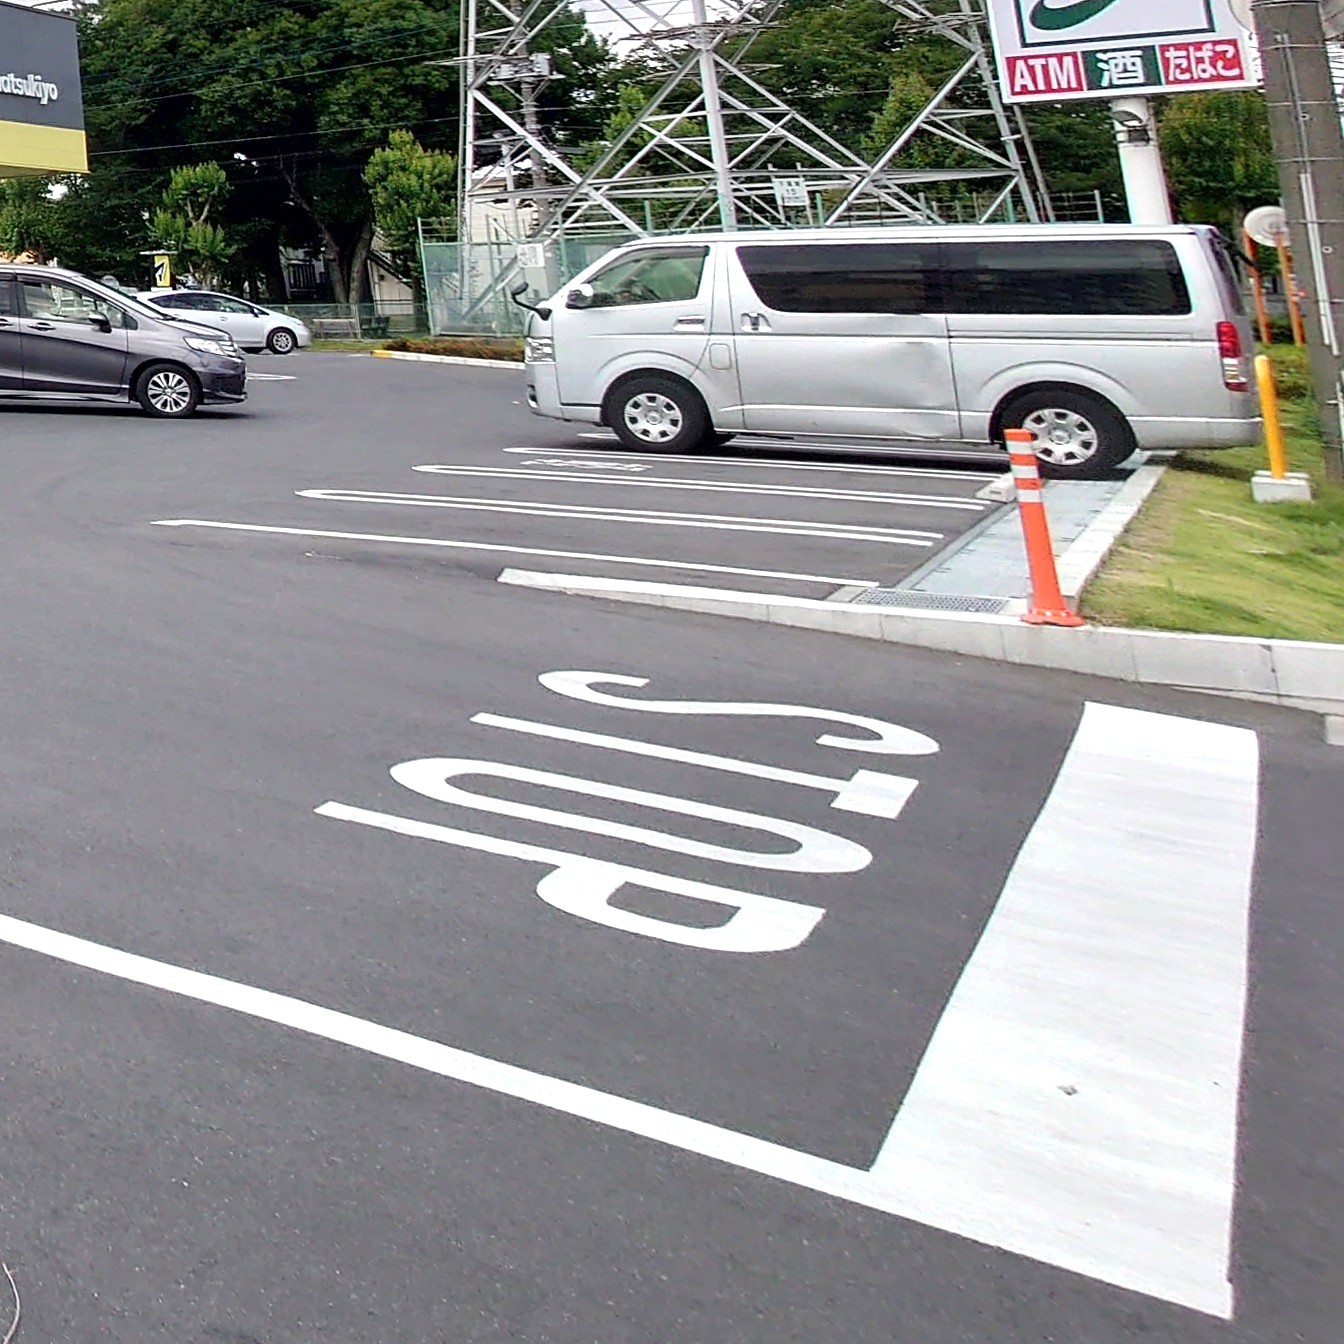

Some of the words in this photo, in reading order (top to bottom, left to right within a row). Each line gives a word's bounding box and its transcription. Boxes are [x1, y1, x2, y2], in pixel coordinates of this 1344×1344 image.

[1013, 56, 1079, 93] ATM
[1095, 49, 1144, 87] 酒
[1164, 43, 1241, 81] たばこ
[313, 670, 940, 952] STOP
